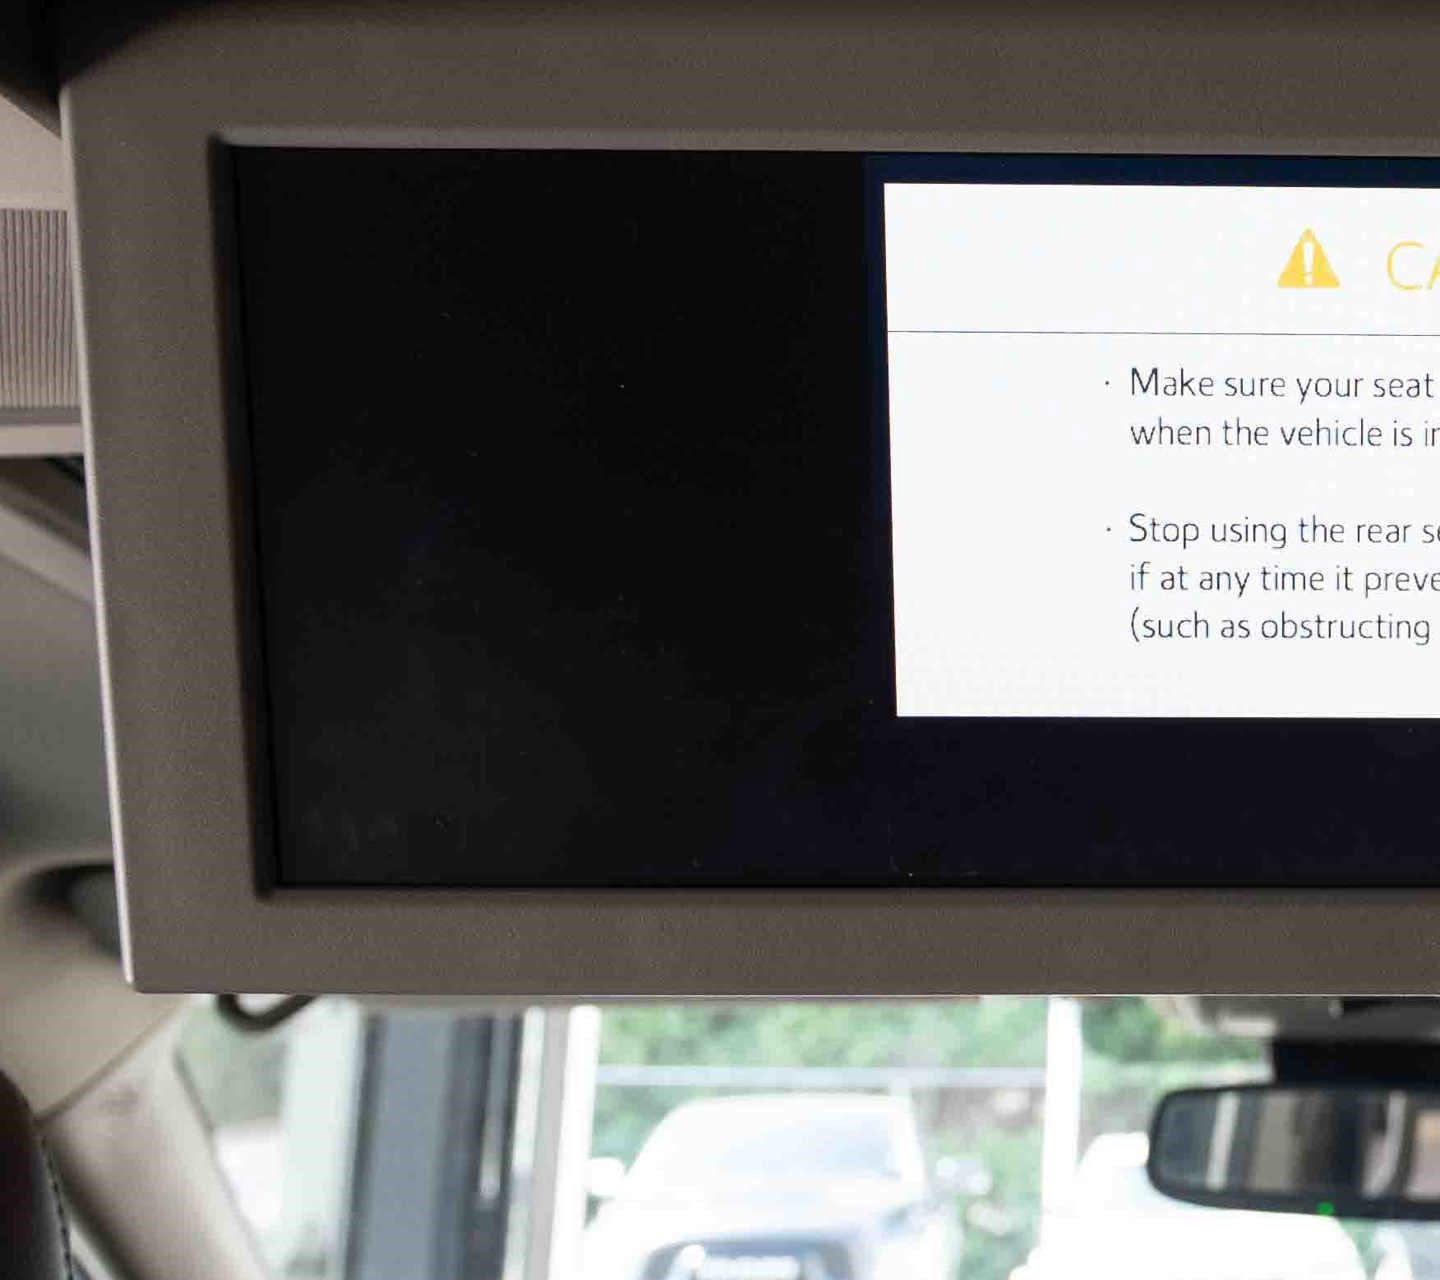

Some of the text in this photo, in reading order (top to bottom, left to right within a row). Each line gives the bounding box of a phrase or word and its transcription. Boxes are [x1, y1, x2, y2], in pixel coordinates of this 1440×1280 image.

[1130, 367, 1214, 397] Make
[1224, 377, 1286, 397] sure
[1296, 377, 1364, 405] your
[1373, 372, 1435, 399] seat
[1130, 415, 1211, 446] when
[1222, 416, 1269, 446] the
[1280, 417, 1383, 447] vehicle
[1393, 419, 1413, 447] is
[1129, 512, 1200, 550] Stop
[1211, 516, 1287, 550] using
[1298, 514, 1345, 544] the
[1356, 523, 1412, 544] rear
[1130, 560, 1152, 591] if
[1160, 565, 1189, 591] at
[1199, 571, 1251, 598] any
[1260, 564, 1325, 592] time
[1336, 565, 1353, 592] it
[1130, 606, 1209, 643] (such
[1220, 619, 1251, 639] as
[1261, 610, 1430, 646] obstructing
